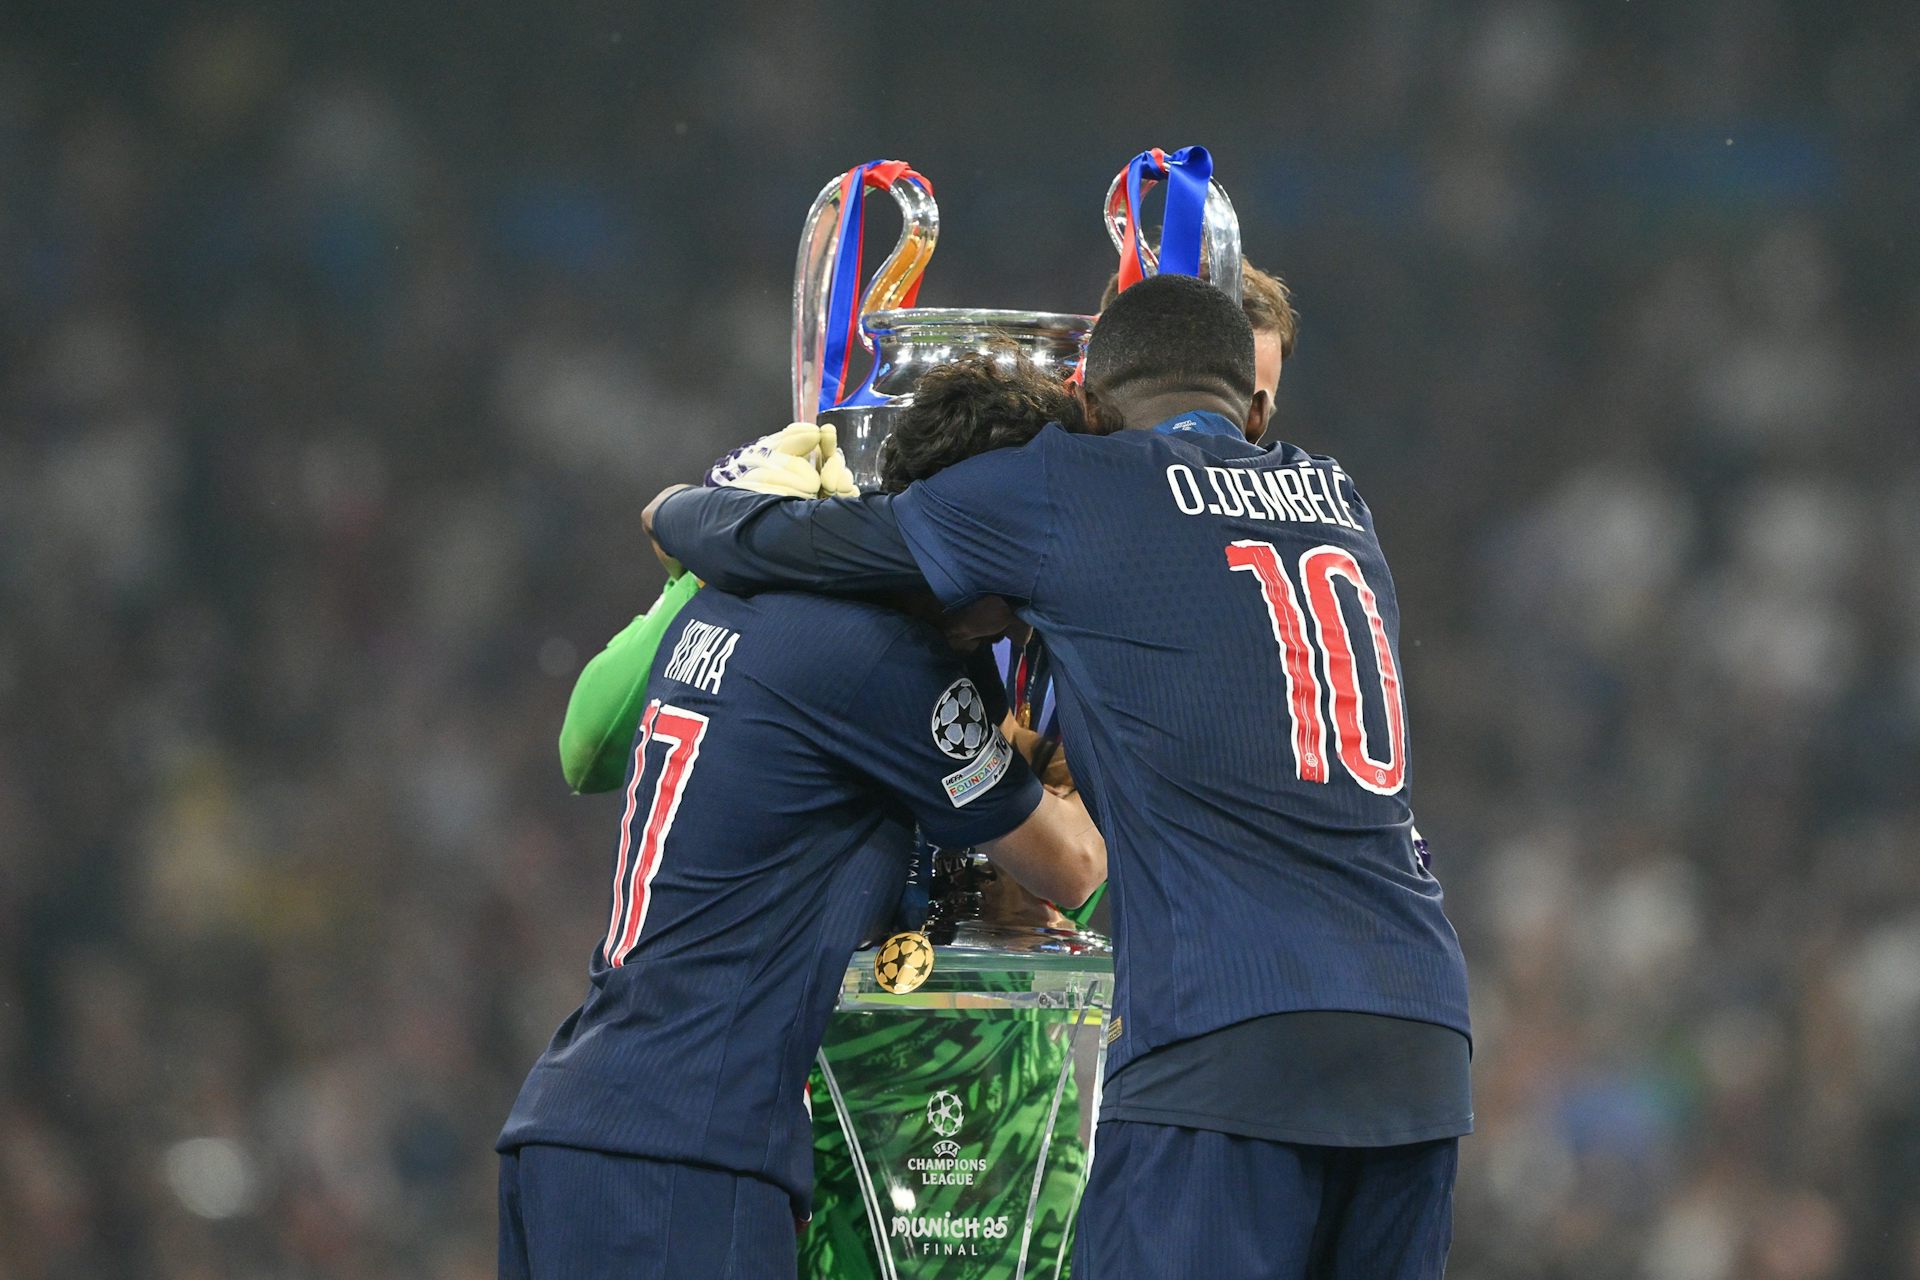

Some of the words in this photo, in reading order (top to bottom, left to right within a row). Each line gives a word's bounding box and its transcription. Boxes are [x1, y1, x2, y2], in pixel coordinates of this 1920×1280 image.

[1166, 461, 1364, 531] O.DEMBÉLÉ
[1225, 539, 1406, 796] 10
[945, 774, 963, 786] UEFA
[603, 698, 709, 968] 17
[934, 1141, 959, 1155] UEFA
[907, 1158, 987, 1172] CHAMPIONS
[922, 1173, 974, 1185] LEAGUE
[983, 1216, 1009, 1239] 25
[923, 1243, 978, 1256] FINAL
